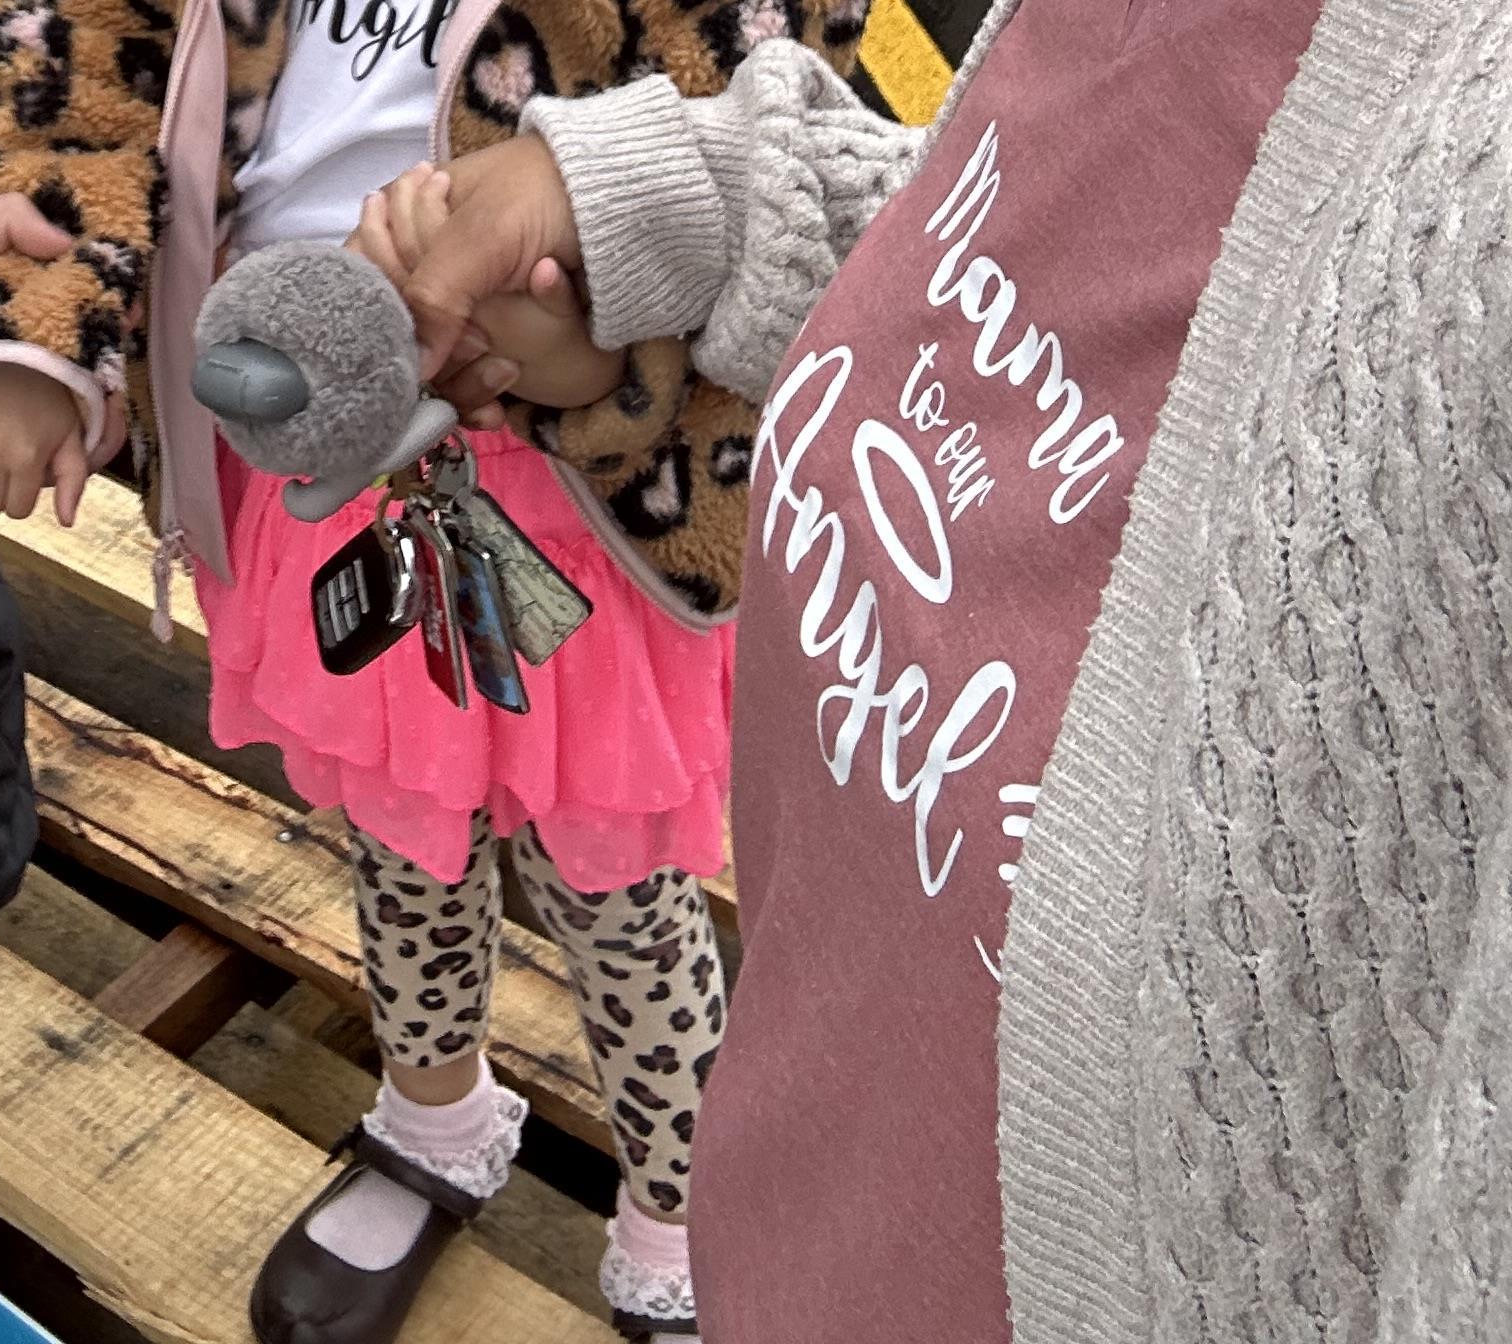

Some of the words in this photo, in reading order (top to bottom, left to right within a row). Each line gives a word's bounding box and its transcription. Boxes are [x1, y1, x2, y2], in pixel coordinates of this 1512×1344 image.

[899, 342, 949, 432] to
[935, 421, 995, 523] our
[924, 119, 1125, 525] Mama
[749, 343, 1016, 898] Angel
